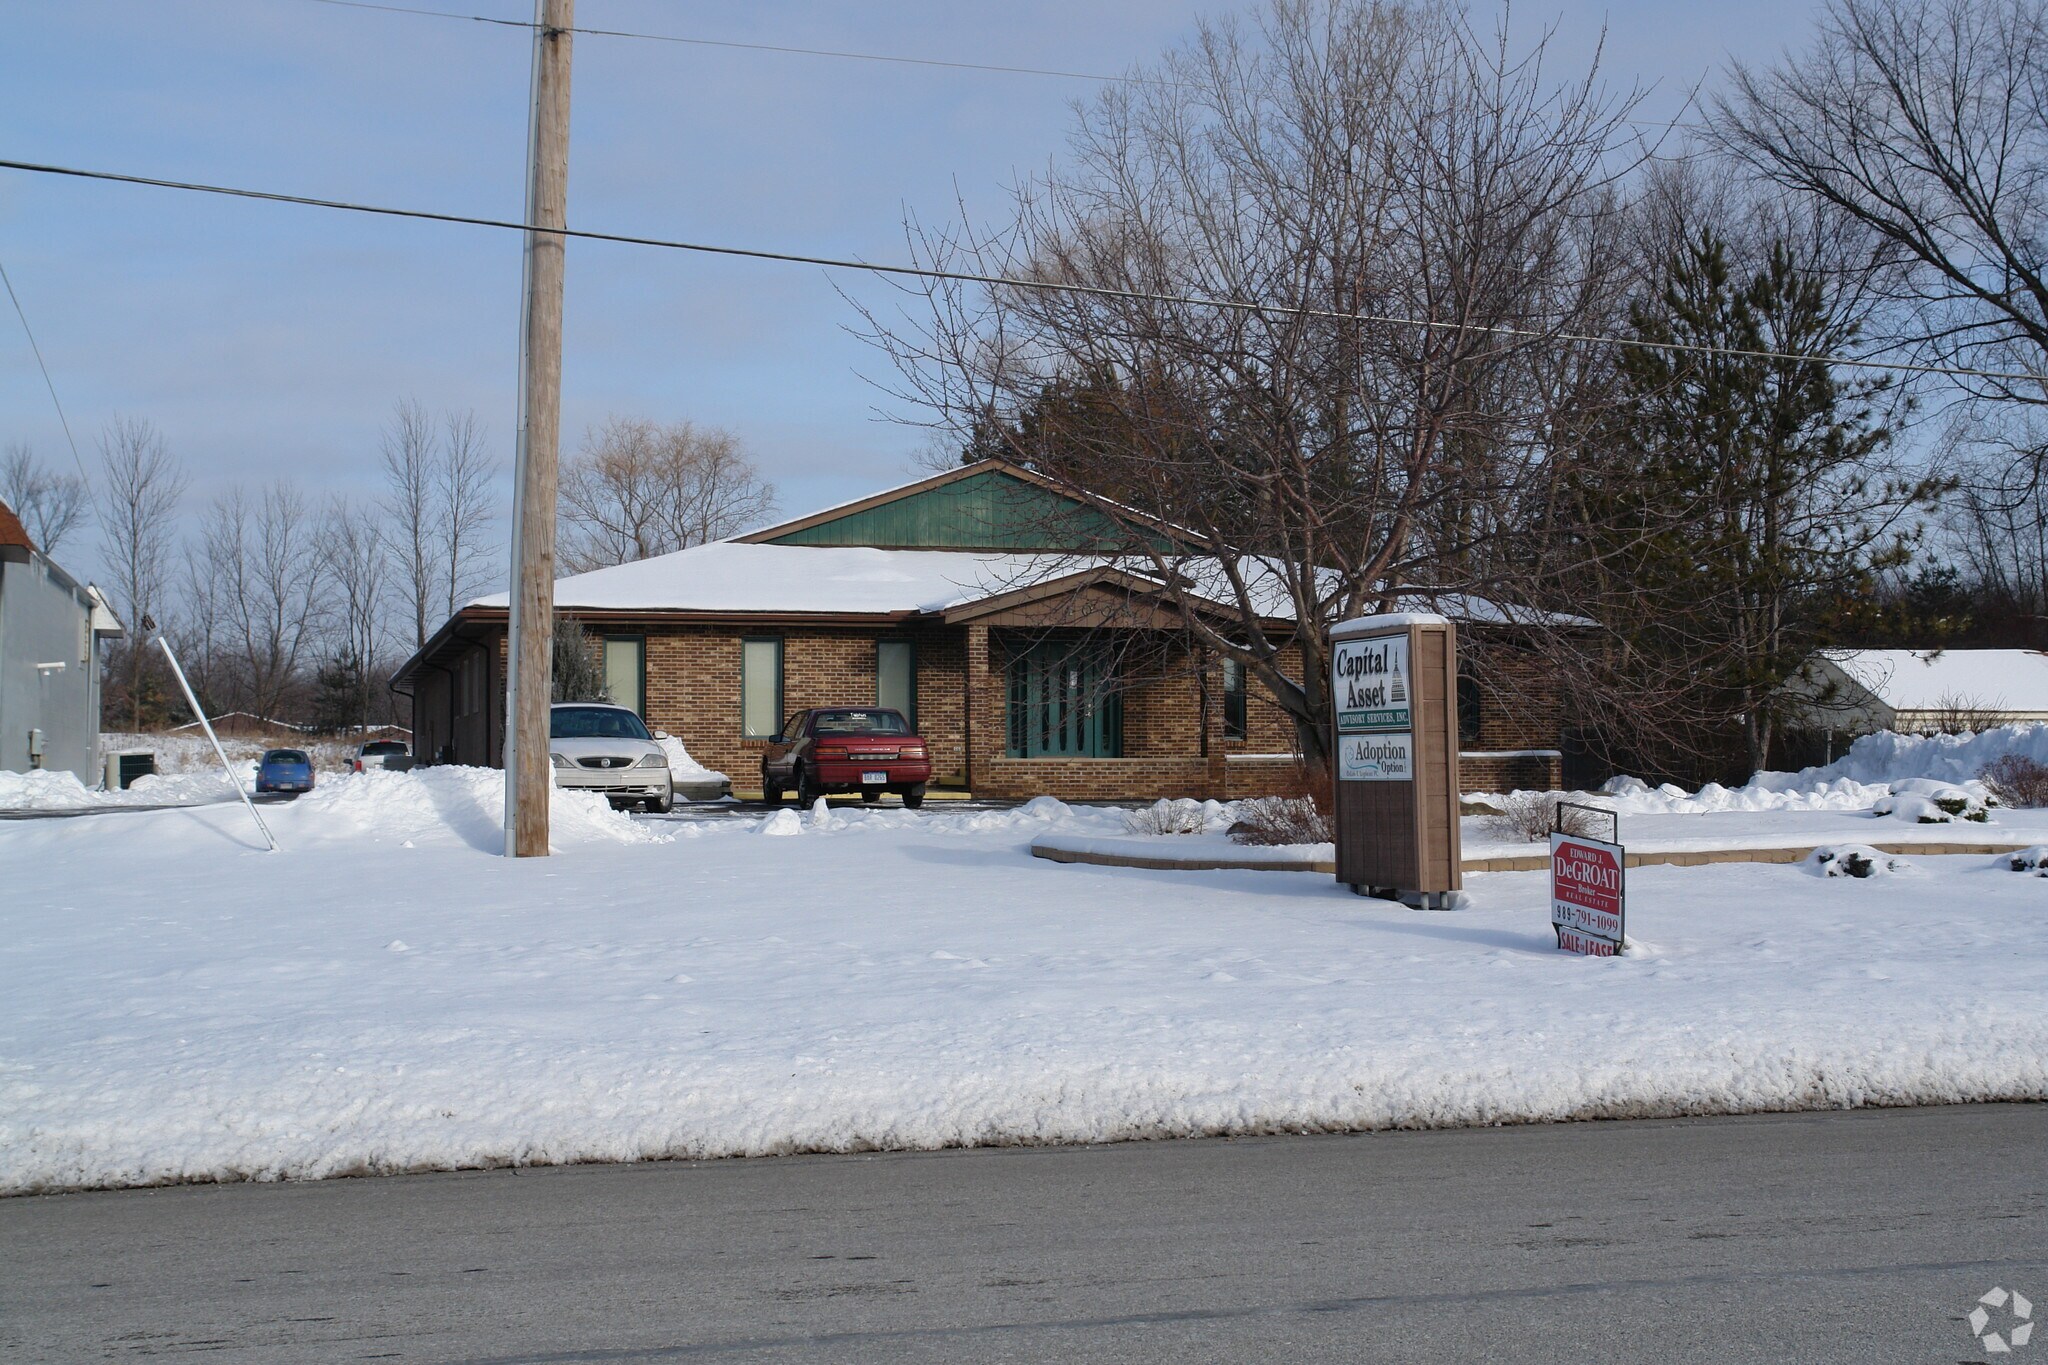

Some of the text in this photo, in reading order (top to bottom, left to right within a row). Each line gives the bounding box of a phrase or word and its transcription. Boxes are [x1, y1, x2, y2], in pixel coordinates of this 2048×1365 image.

[1337, 644, 1388, 681] Capital
[1346, 680, 1386, 708] Asset
[1340, 711, 1408, 724] ADVISORY SERVICES, INC.
[1355, 741, 1406, 764] Adoption
[1381, 761, 1403, 775] Option
[1570, 848, 1603, 864] EDWARD J.
[1557, 857, 1617, 889] DeGROAT
[1566, 891, 1609, 907] REAL ESTATE
[1578, 884, 1595, 896] Broker
[1557, 905, 1618, 932] 989-791-1099
[1561, 932, 1580, 953] SALE
